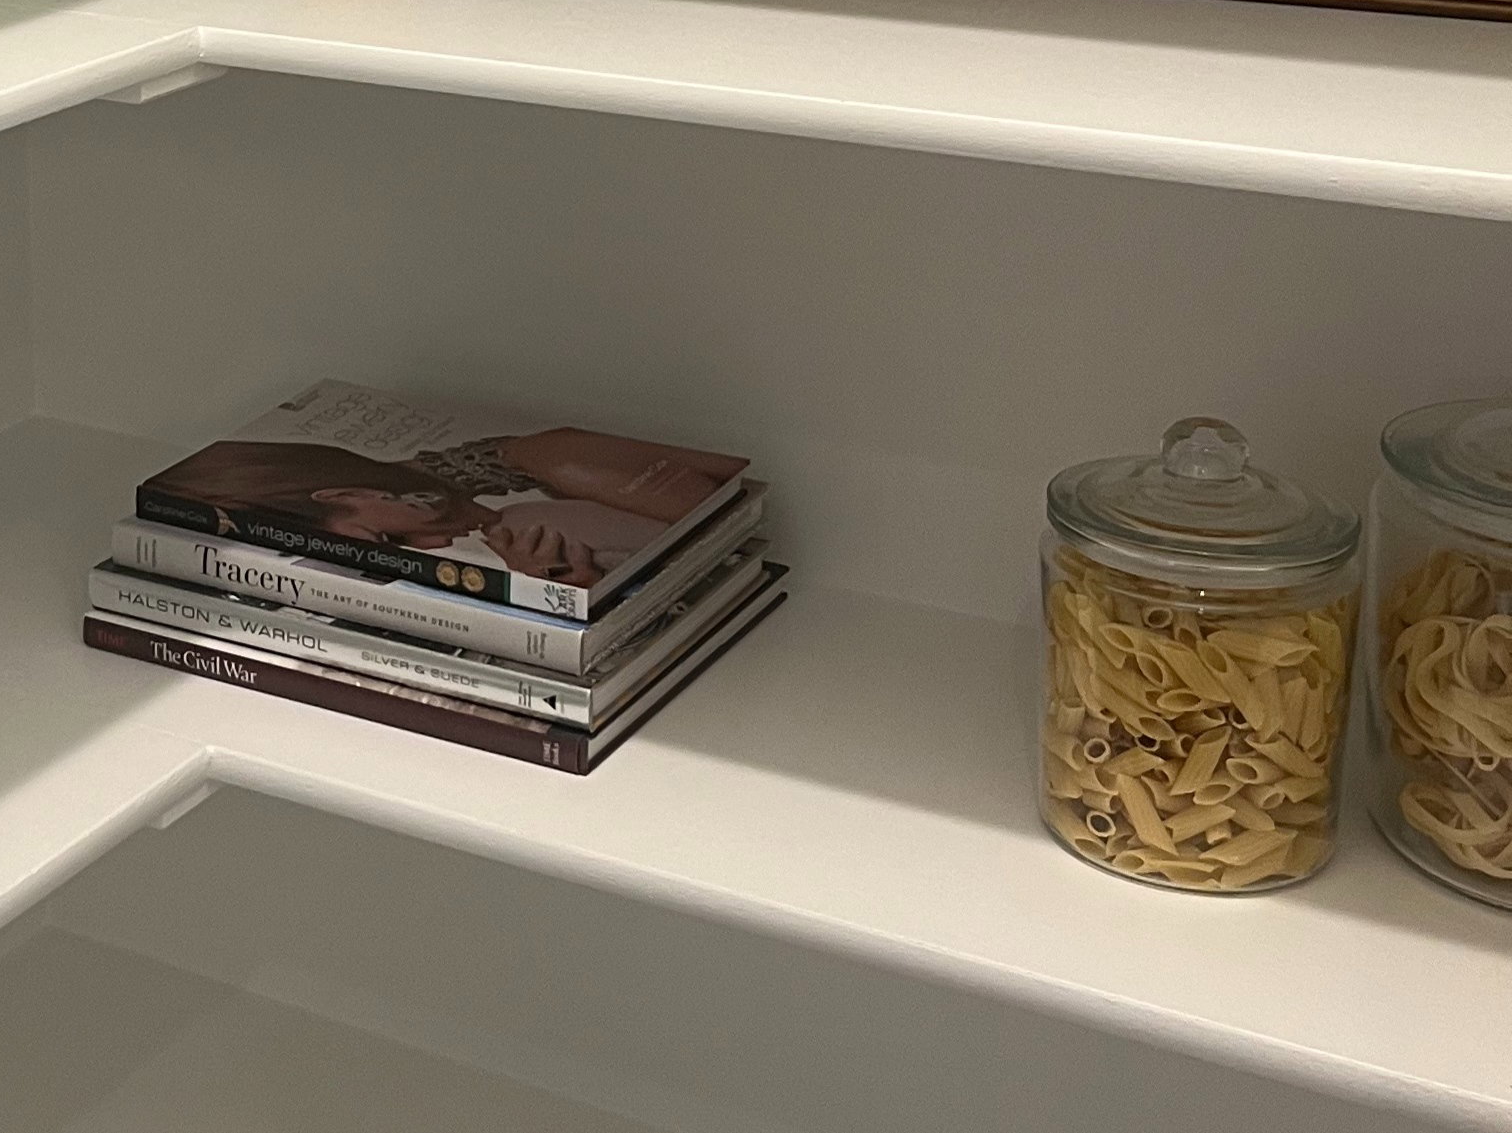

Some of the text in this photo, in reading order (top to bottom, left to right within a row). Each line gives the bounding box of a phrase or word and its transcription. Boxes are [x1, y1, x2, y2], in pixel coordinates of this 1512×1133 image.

[247, 521, 423, 575] vintage jewelry design
[194, 543, 306, 606] Tracery
[118, 590, 328, 653] HALSTON & WARHOL
[310, 587, 470, 632] THE ART OF SOUTHERN DESIGN
[150, 639, 181, 665] The
[183, 650, 221, 676] Civil
[224, 661, 258, 685] War
[361, 651, 481, 689] SILVER & SUEDE
